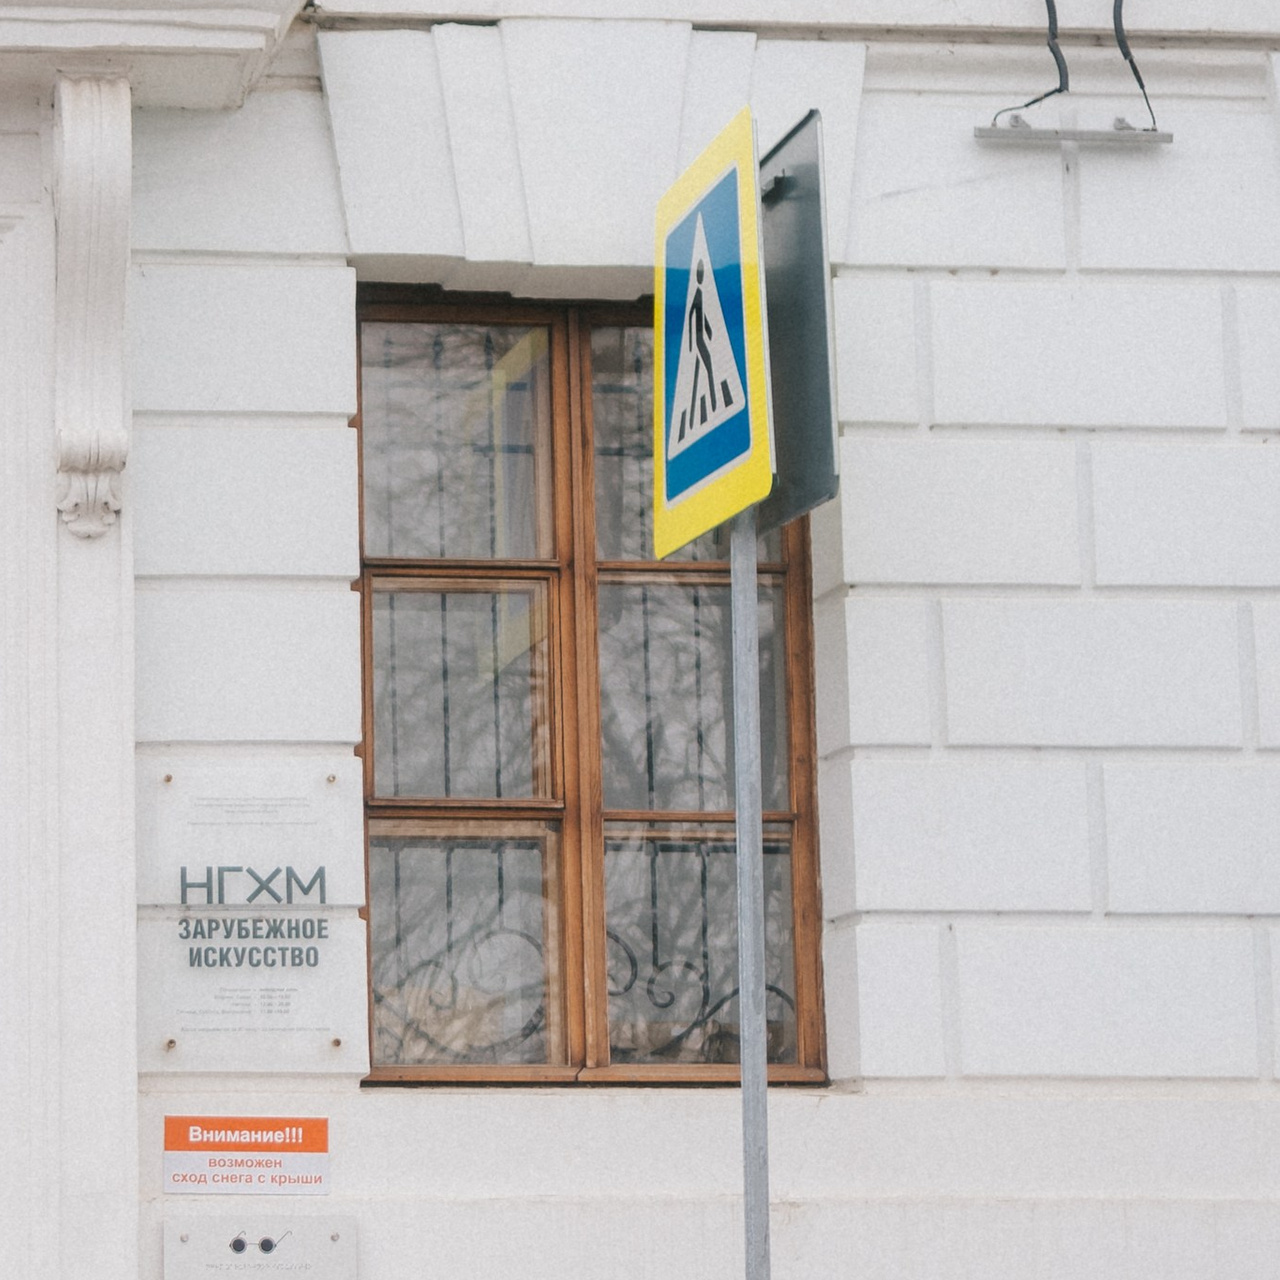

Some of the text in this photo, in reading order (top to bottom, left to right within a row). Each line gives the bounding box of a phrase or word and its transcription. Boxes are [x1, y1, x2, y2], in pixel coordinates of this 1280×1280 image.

[179, 865, 327, 905] НГХМ
[178, 916, 329, 941] ЗАРУБЕЖНОЕ
[188, 945, 320, 969] ИСКУССТВО
[188, 1125, 303, 1144] Внимание!!!
[207, 1157, 283, 1169] возможен
[171, 1172, 323, 1186] сход снега с крыши
